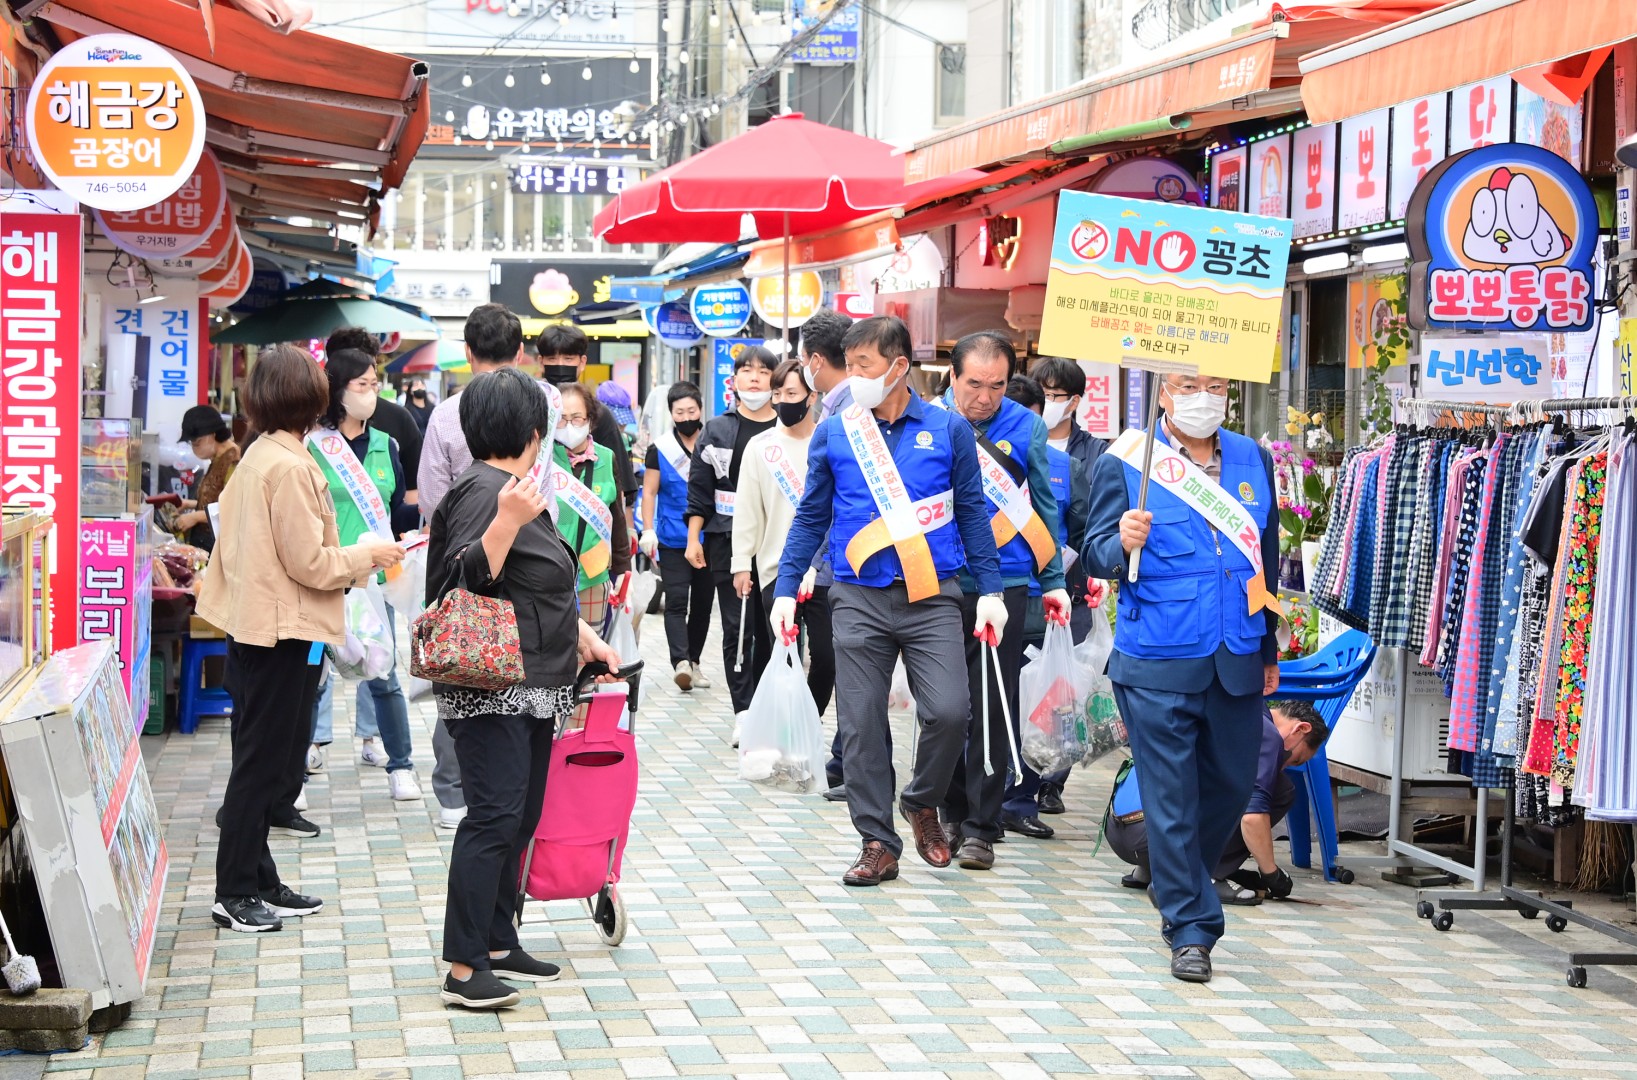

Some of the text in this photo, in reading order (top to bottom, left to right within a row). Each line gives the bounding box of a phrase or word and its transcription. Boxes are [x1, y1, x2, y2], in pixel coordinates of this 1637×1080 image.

[46, 80, 184, 130] 해금강
[69, 137, 162, 169] 곰장어
[86, 182, 147, 193] 746-5054
[1343, 208, 1385, 228] 741-4065
[136, 235, 177, 248] 우거지탕
[1113, 227, 1271, 280] NO 꽁초
[1056, 295, 1272, 335] 해양 미세플라스틱이 되어 물고기 먹이가 됩니다
[1109, 286, 1219, 312] 바다로 흘러간 담배꽁초!
[1433, 269, 1586, 323] 뽀뽀통닭
[1090, 315, 1230, 345] 담배꽁초 없는 아름다운 해운대
[1139, 337, 1190, 356] 해운대구
[159, 309, 189, 397] 건어물
[1427, 347, 1542, 387] 신선한
[1083, 375, 1110, 433] 전설
[859, 415, 890, 468] 담배꽁초
[1182, 476, 1244, 533] 담배꽁초
[82, 529, 131, 557] 옛날
[82, 564, 128, 660] 보리
